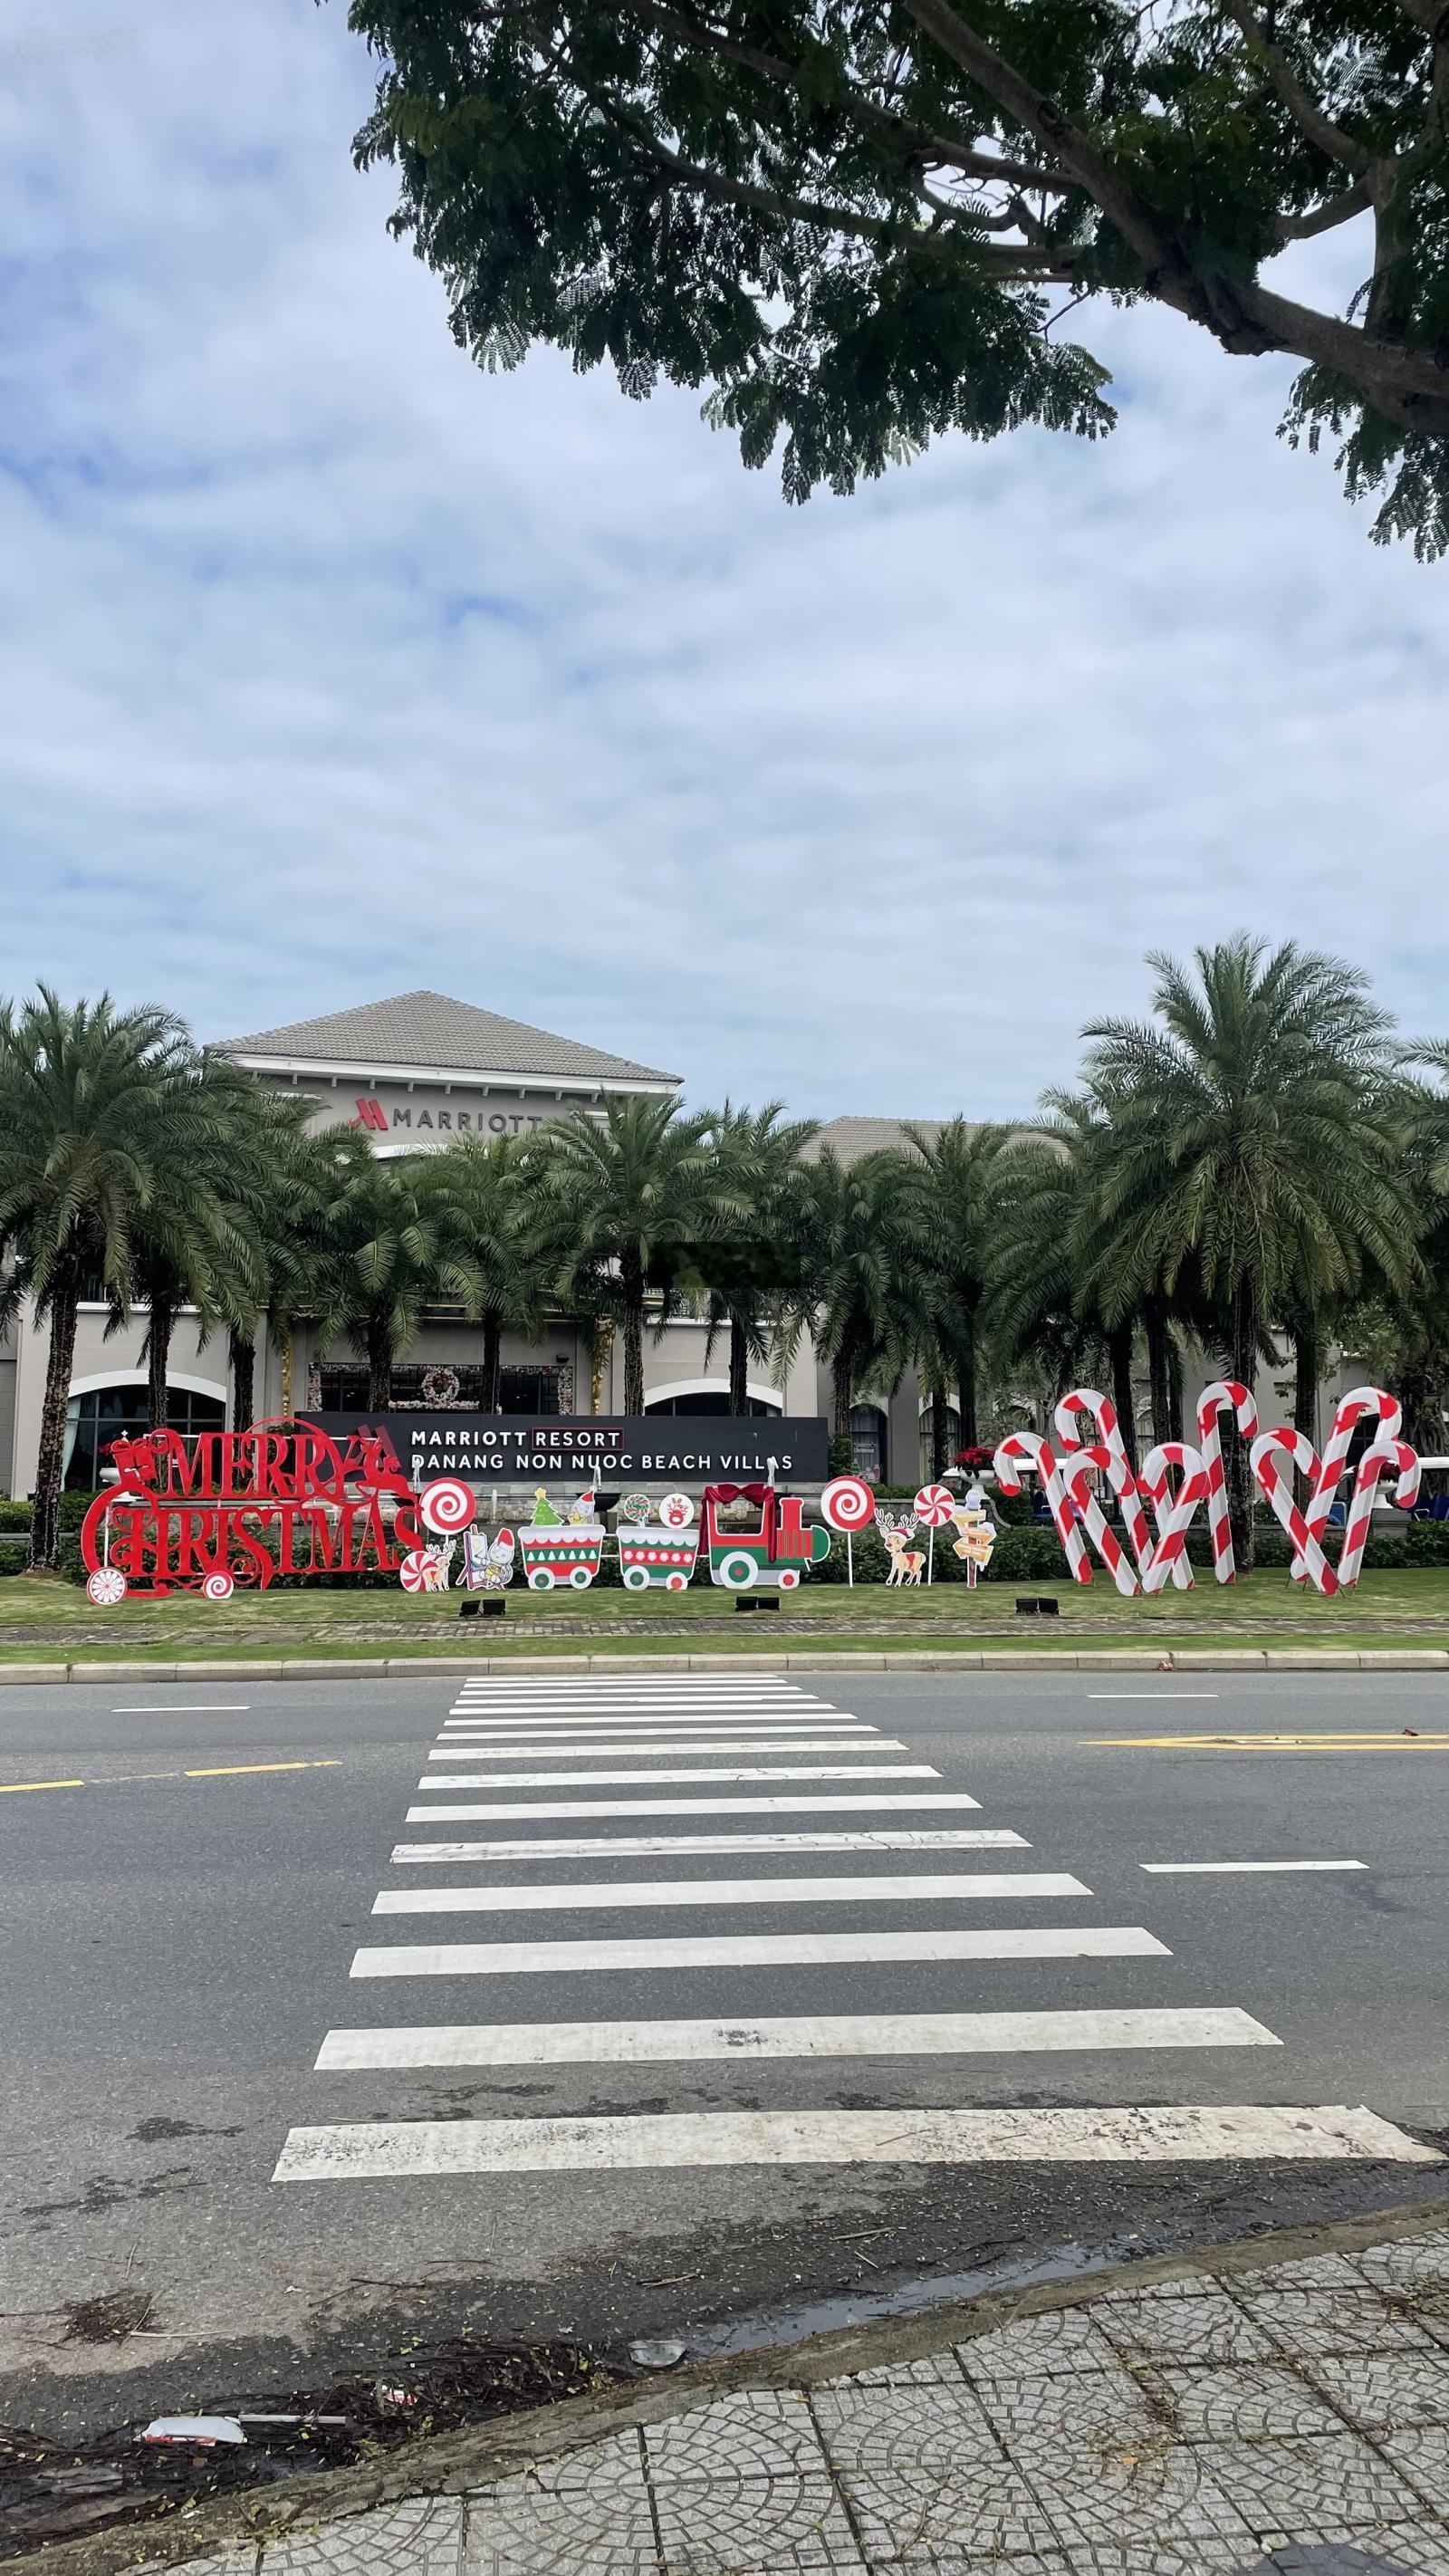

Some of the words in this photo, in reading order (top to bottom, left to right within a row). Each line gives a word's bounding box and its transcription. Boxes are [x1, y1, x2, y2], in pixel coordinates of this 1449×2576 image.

[393, 1108, 543, 1133] MARRIOTT
[411, 1430, 527, 1447] MARRIOTT
[535, 1431, 620, 1447] RESORT
[148, 1426, 366, 1507] MERRY
[411, 1454, 504, 1469] DANANG
[515, 1454, 562, 1469] NON
[571, 1454, 633, 1469] NUOC
[641, 1455, 711, 1469] BEACH
[82, 1483, 427, 1599] CHRISTMAS
